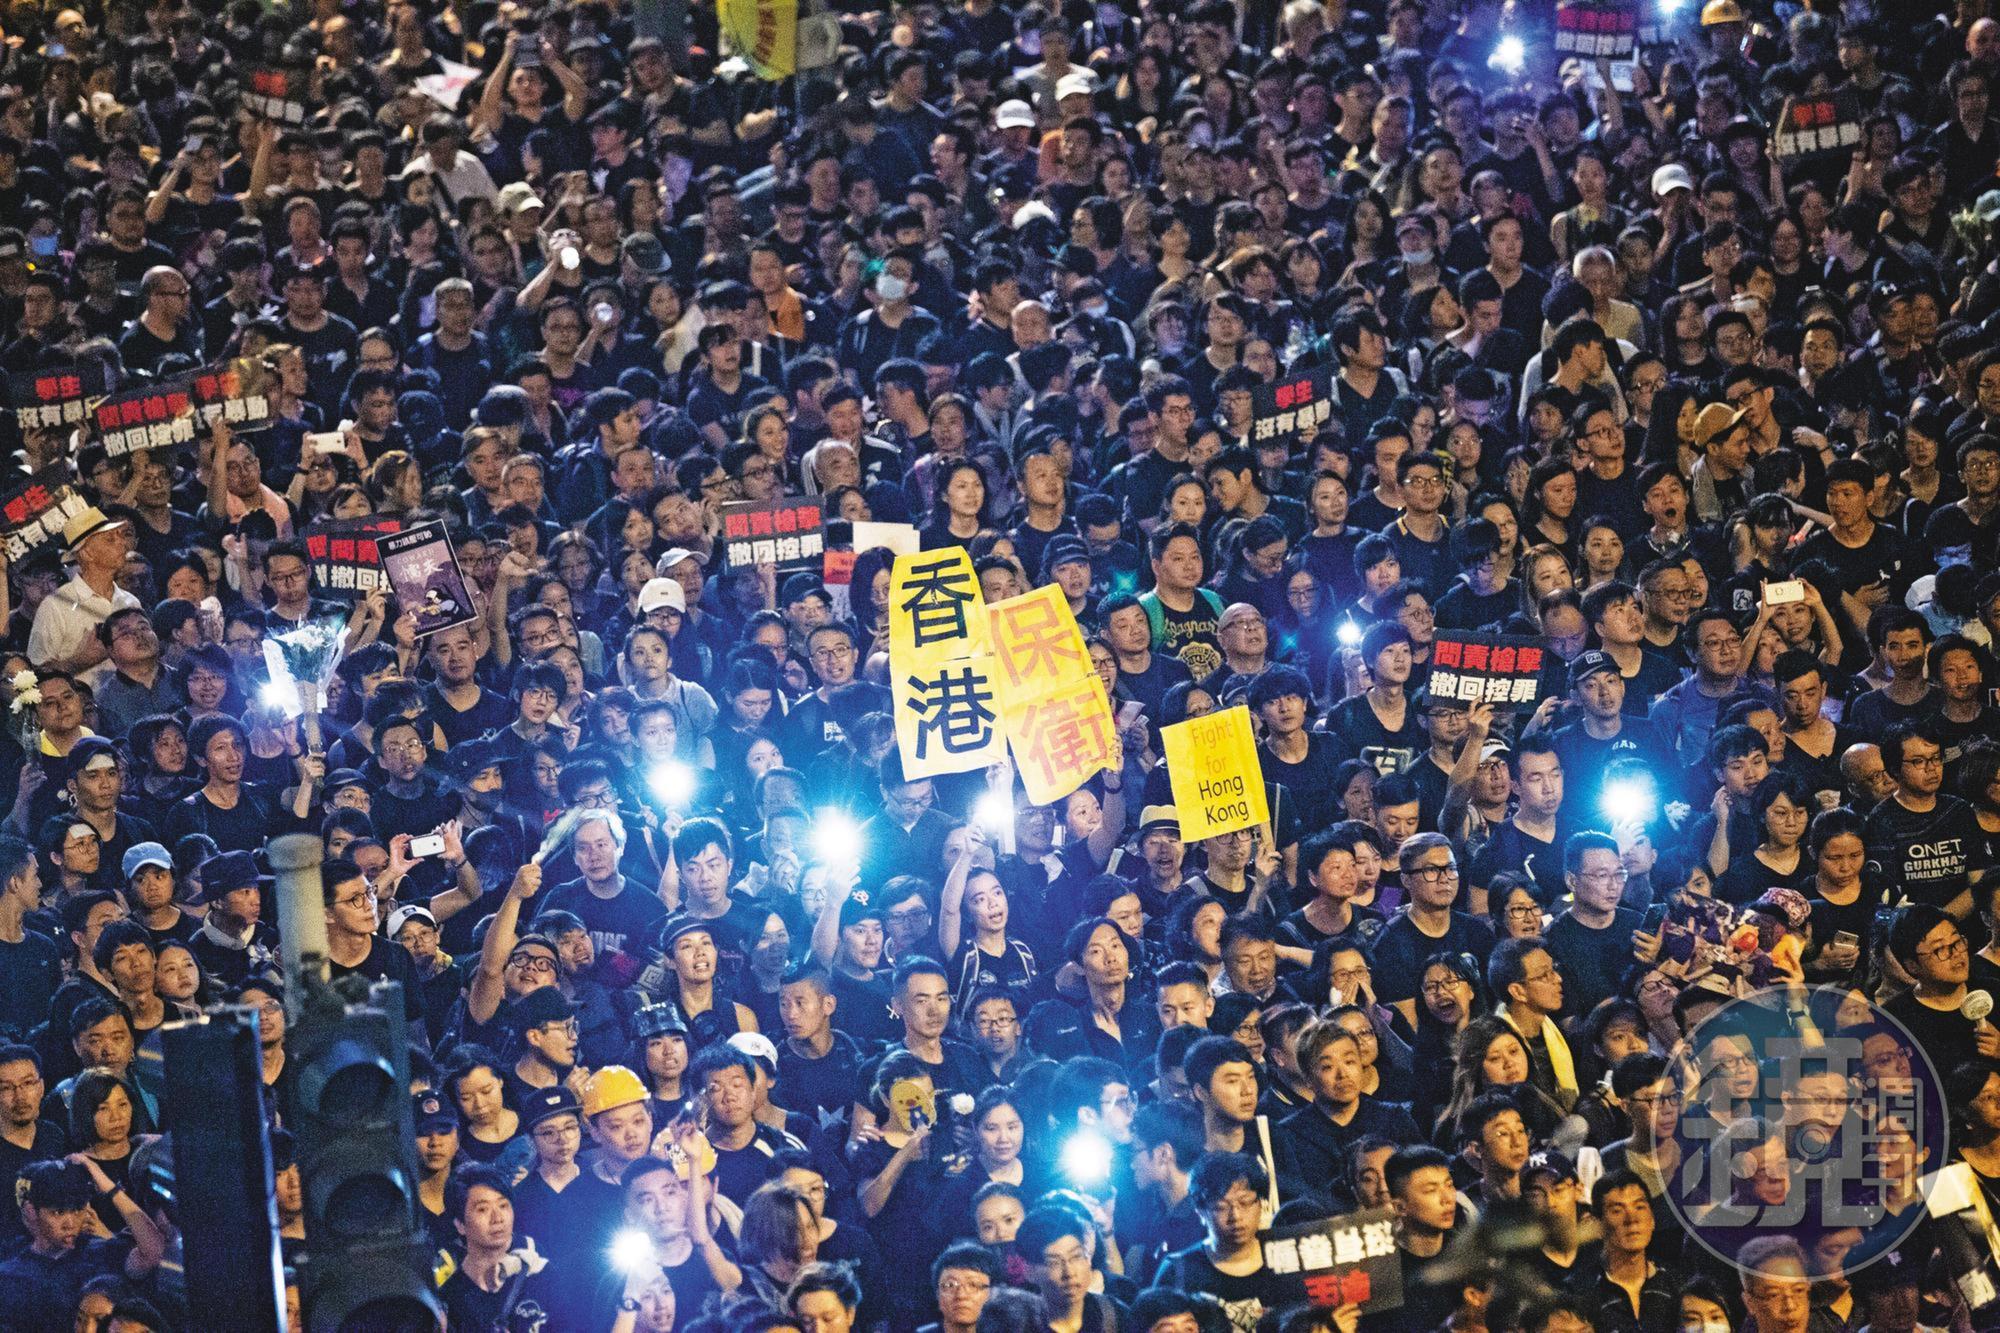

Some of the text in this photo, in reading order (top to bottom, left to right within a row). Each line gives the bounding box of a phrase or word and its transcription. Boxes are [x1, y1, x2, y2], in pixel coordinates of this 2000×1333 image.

[1275, 380, 1312, 409] 學生
[103, 418, 195, 457] 撤回控罪
[725, 505, 821, 538] 問責槍擊
[728, 533, 823, 567] 撤回控罪
[901, 557, 997, 760] 香港
[1433, 640, 1543, 673] 問責槍擊
[990, 596, 1108, 786] 保衛
[1429, 671, 1538, 703] 撤回控罪
[1191, 719, 1234, 749] Fight
[1205, 755, 1228, 775] for
[1198, 775, 1244, 801] Hong
[1205, 801, 1249, 826] Kong
[1908, 838, 1962, 859] QNET
